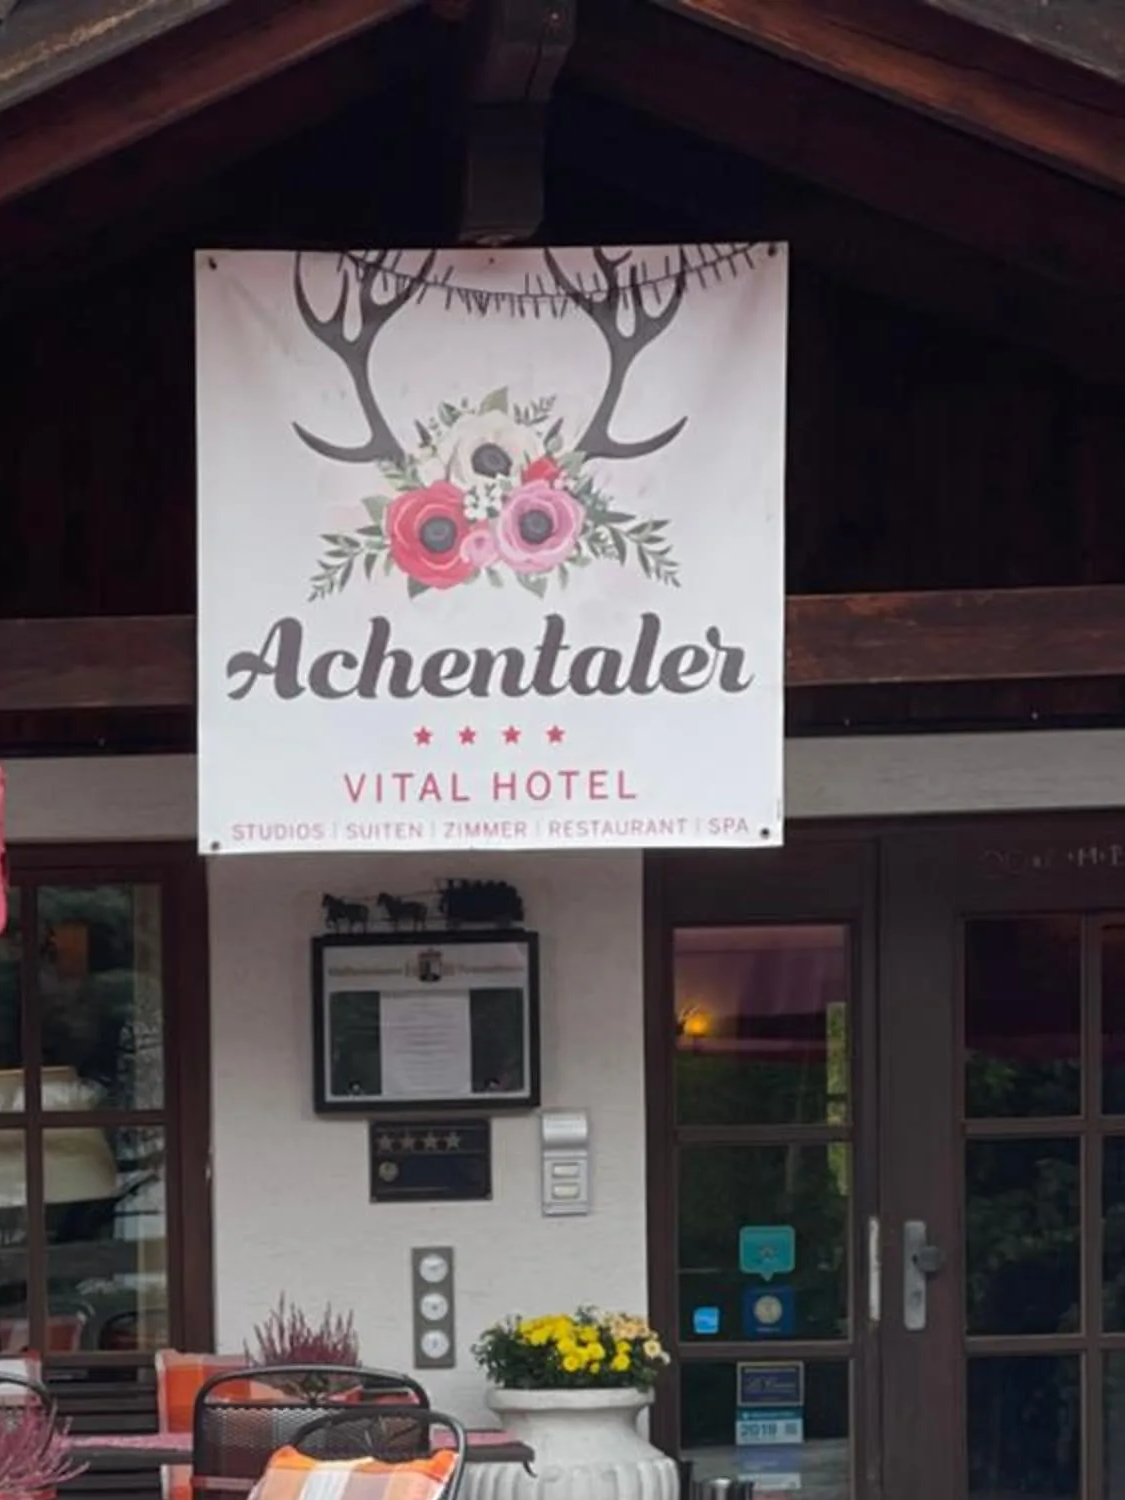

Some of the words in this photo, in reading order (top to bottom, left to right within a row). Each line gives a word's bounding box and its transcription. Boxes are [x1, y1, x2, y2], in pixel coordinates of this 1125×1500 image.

[226, 612, 754, 699] Achentaler
[343, 771, 470, 803] VITAL
[492, 769, 637, 801] HOTEL
[231, 822, 326, 842] STUDIOS
[345, 821, 423, 840] SUITEN
[443, 820, 528, 840] ZIMMER
[548, 817, 689, 838] RESTAURANT
[708, 816, 750, 836] SPA
